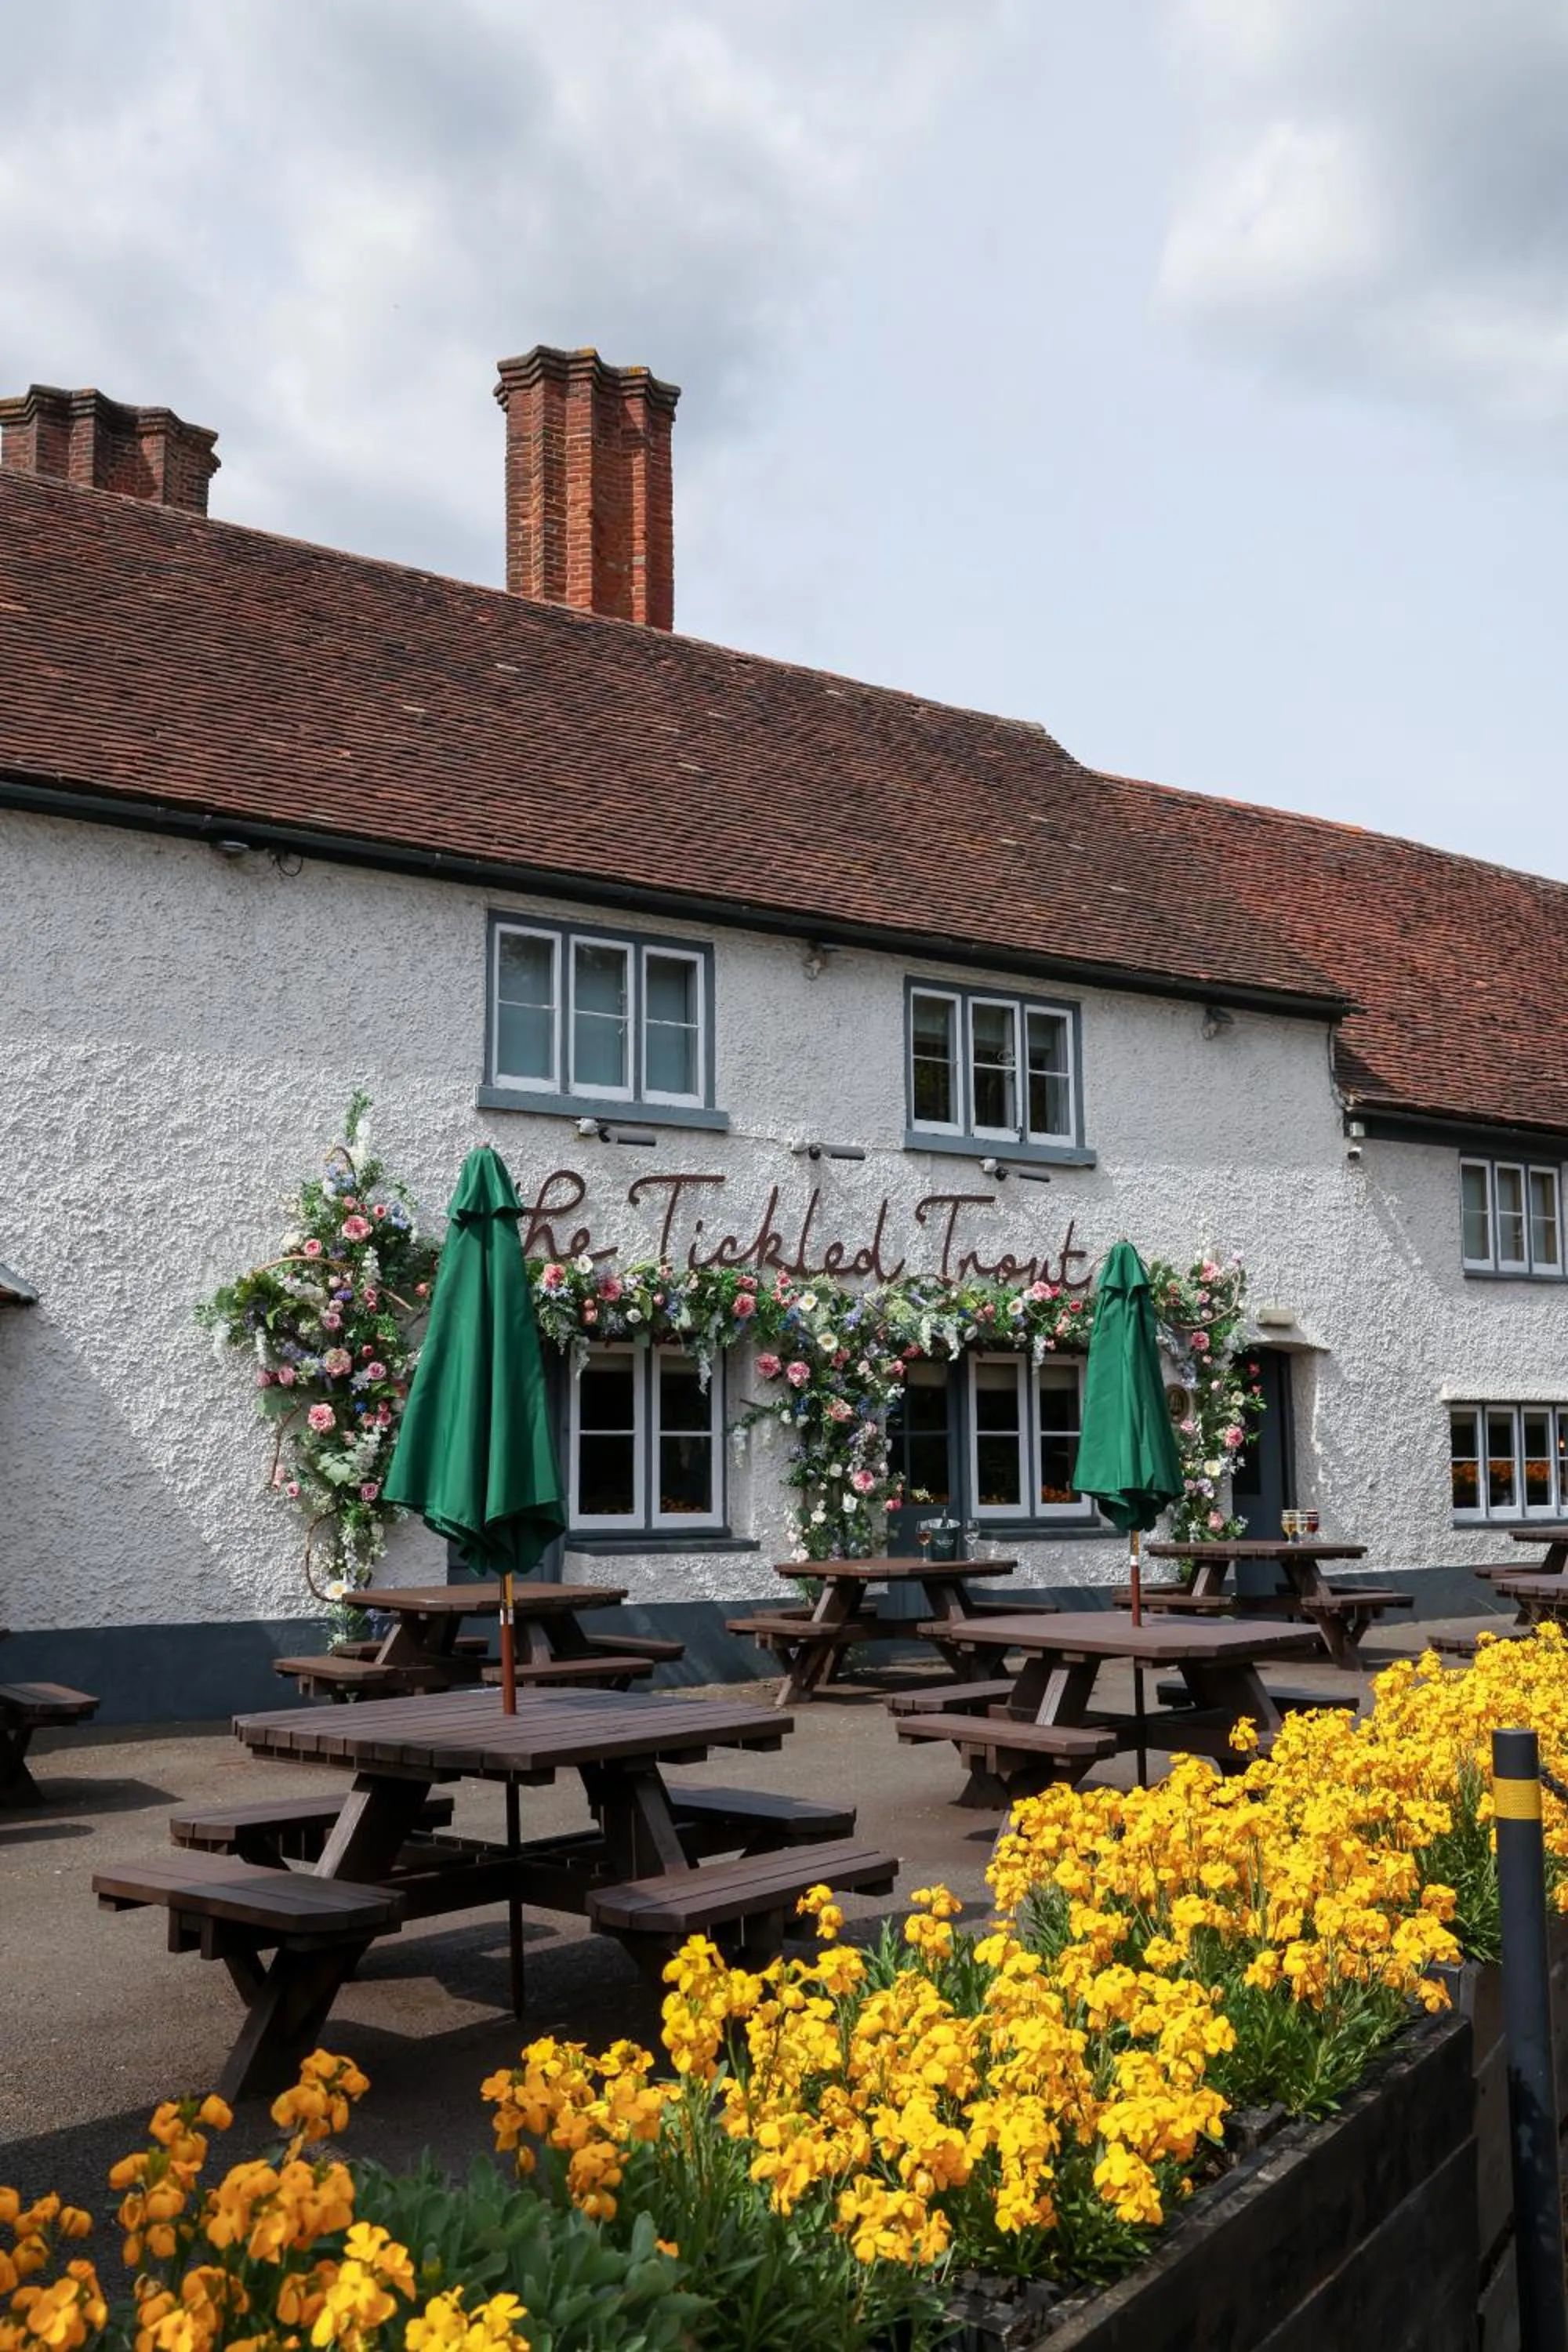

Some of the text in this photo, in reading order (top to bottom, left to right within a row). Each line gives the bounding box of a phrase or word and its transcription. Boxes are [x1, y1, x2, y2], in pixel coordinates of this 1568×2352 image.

[514, 1169, 1092, 1290] he Tickled Trout
